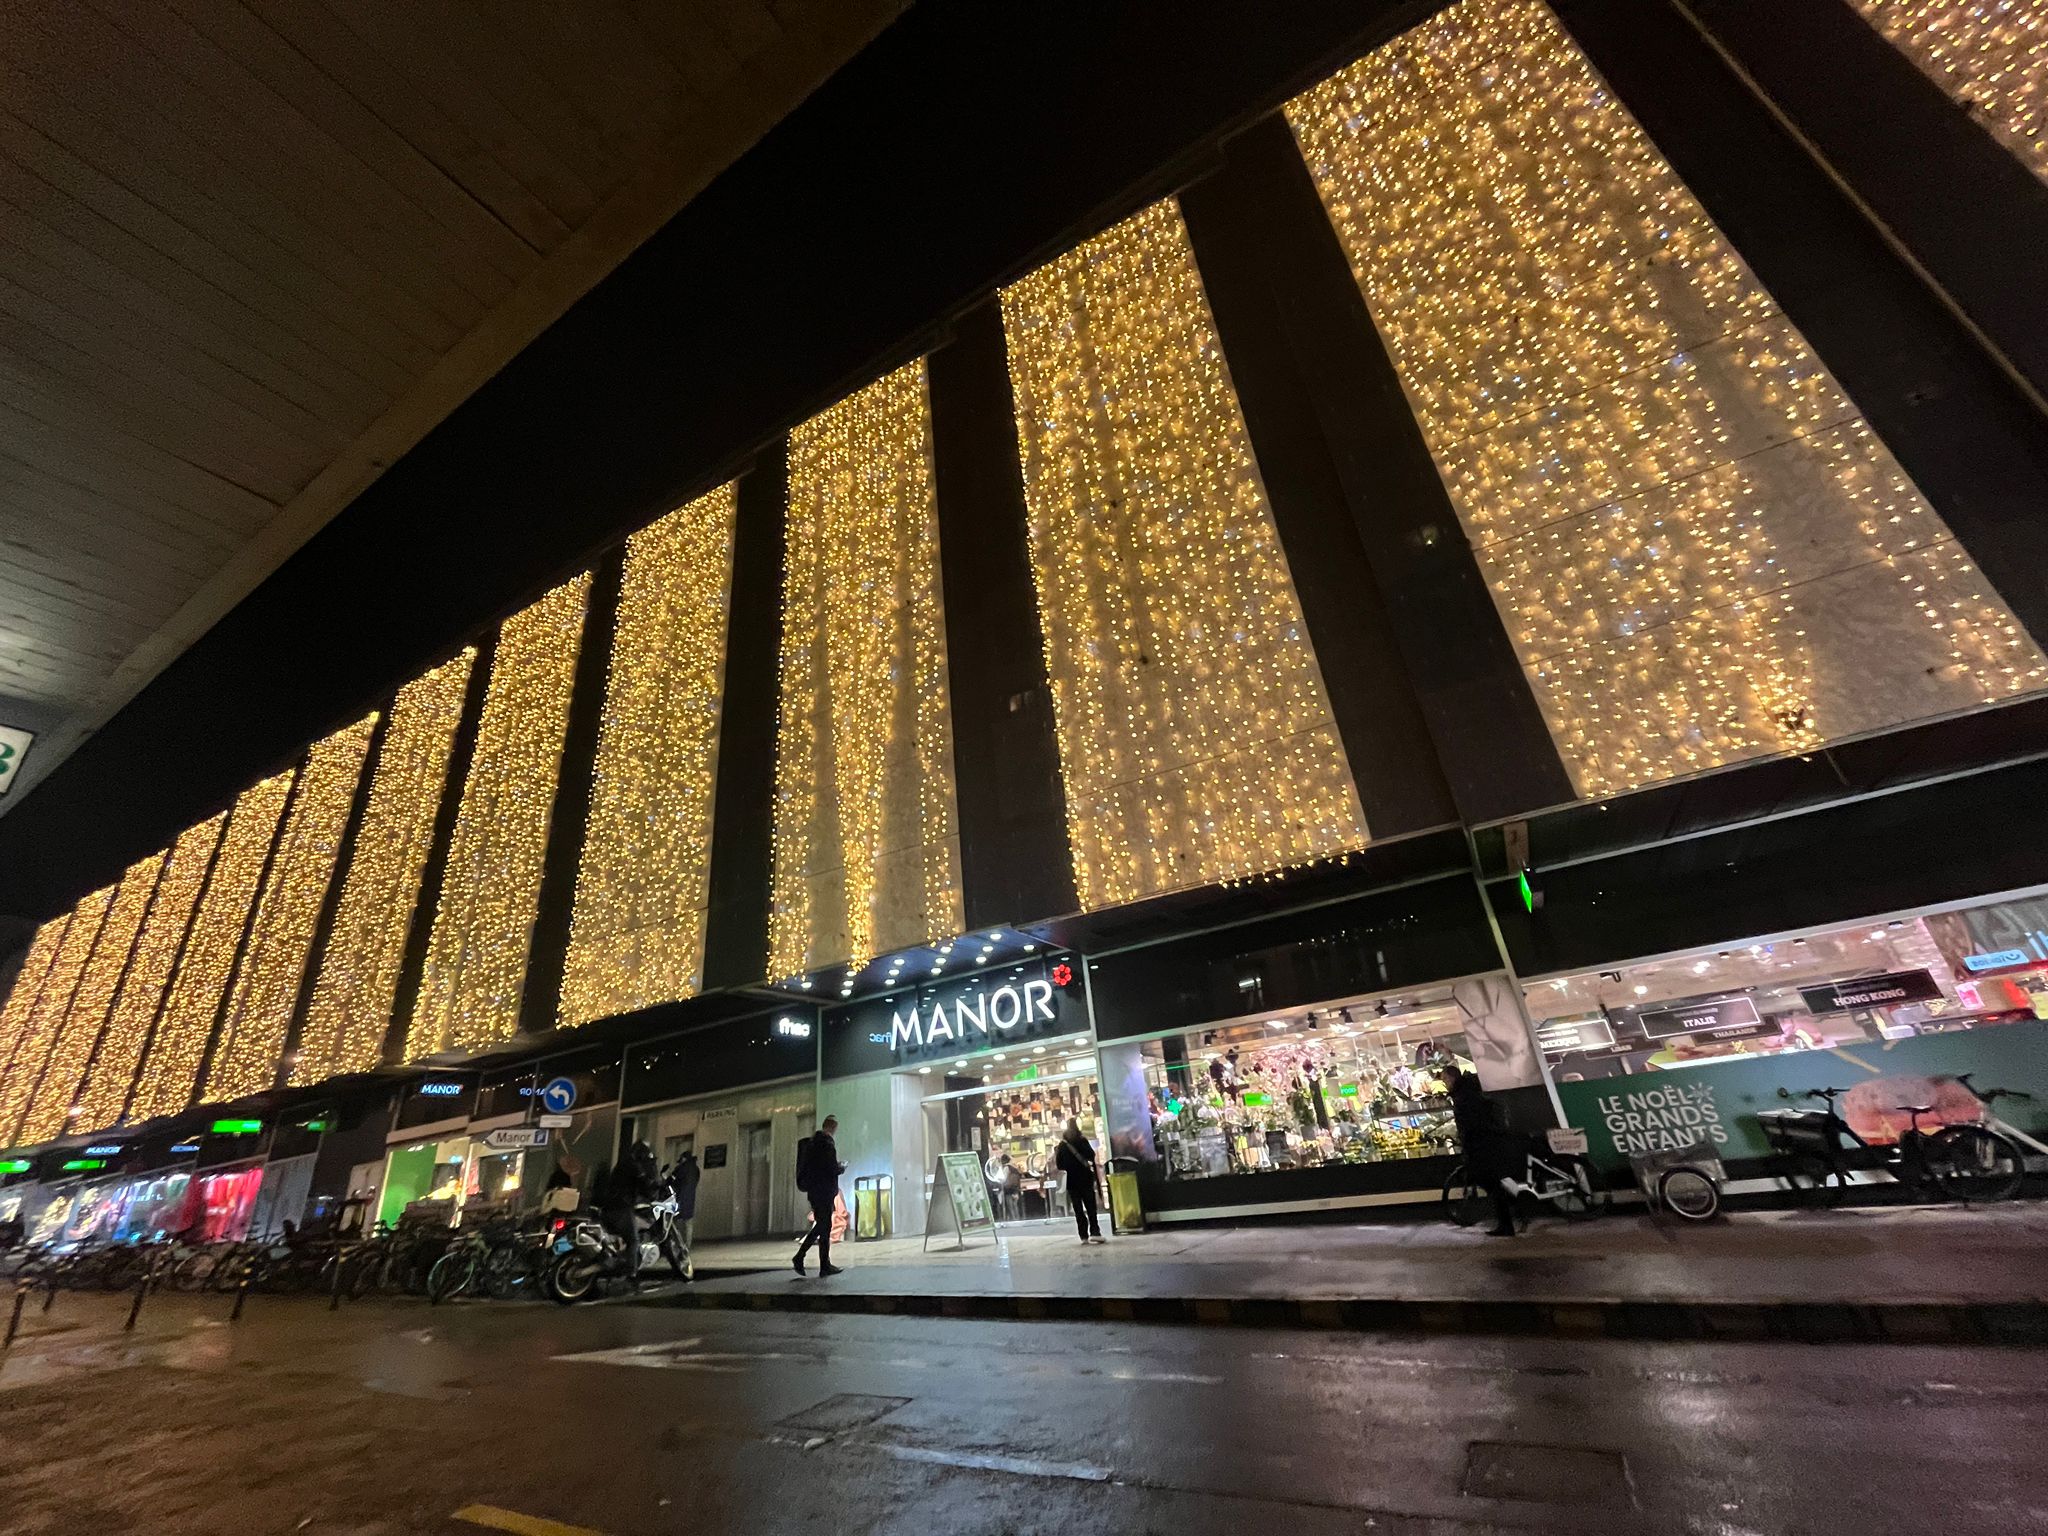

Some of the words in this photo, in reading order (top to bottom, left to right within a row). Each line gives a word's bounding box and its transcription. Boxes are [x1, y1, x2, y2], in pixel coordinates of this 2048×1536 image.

[1832, 993, 1870, 1007] HONG
[1869, 988, 1906, 1001] KONG
[890, 980, 1056, 1051] MANOR
[1683, 1016, 1717, 1028] ITALIE
[778, 1017, 810, 1037] fnac
[421, 1084, 460, 1095] MANOR
[1598, 1095, 1624, 1114] LE
[1627, 1085, 1693, 1112] NOËL
[1606, 1103, 1719, 1133] GRANDS
[496, 1132, 531, 1143] Manor
[1612, 1124, 1729, 1154] ENFANTS
